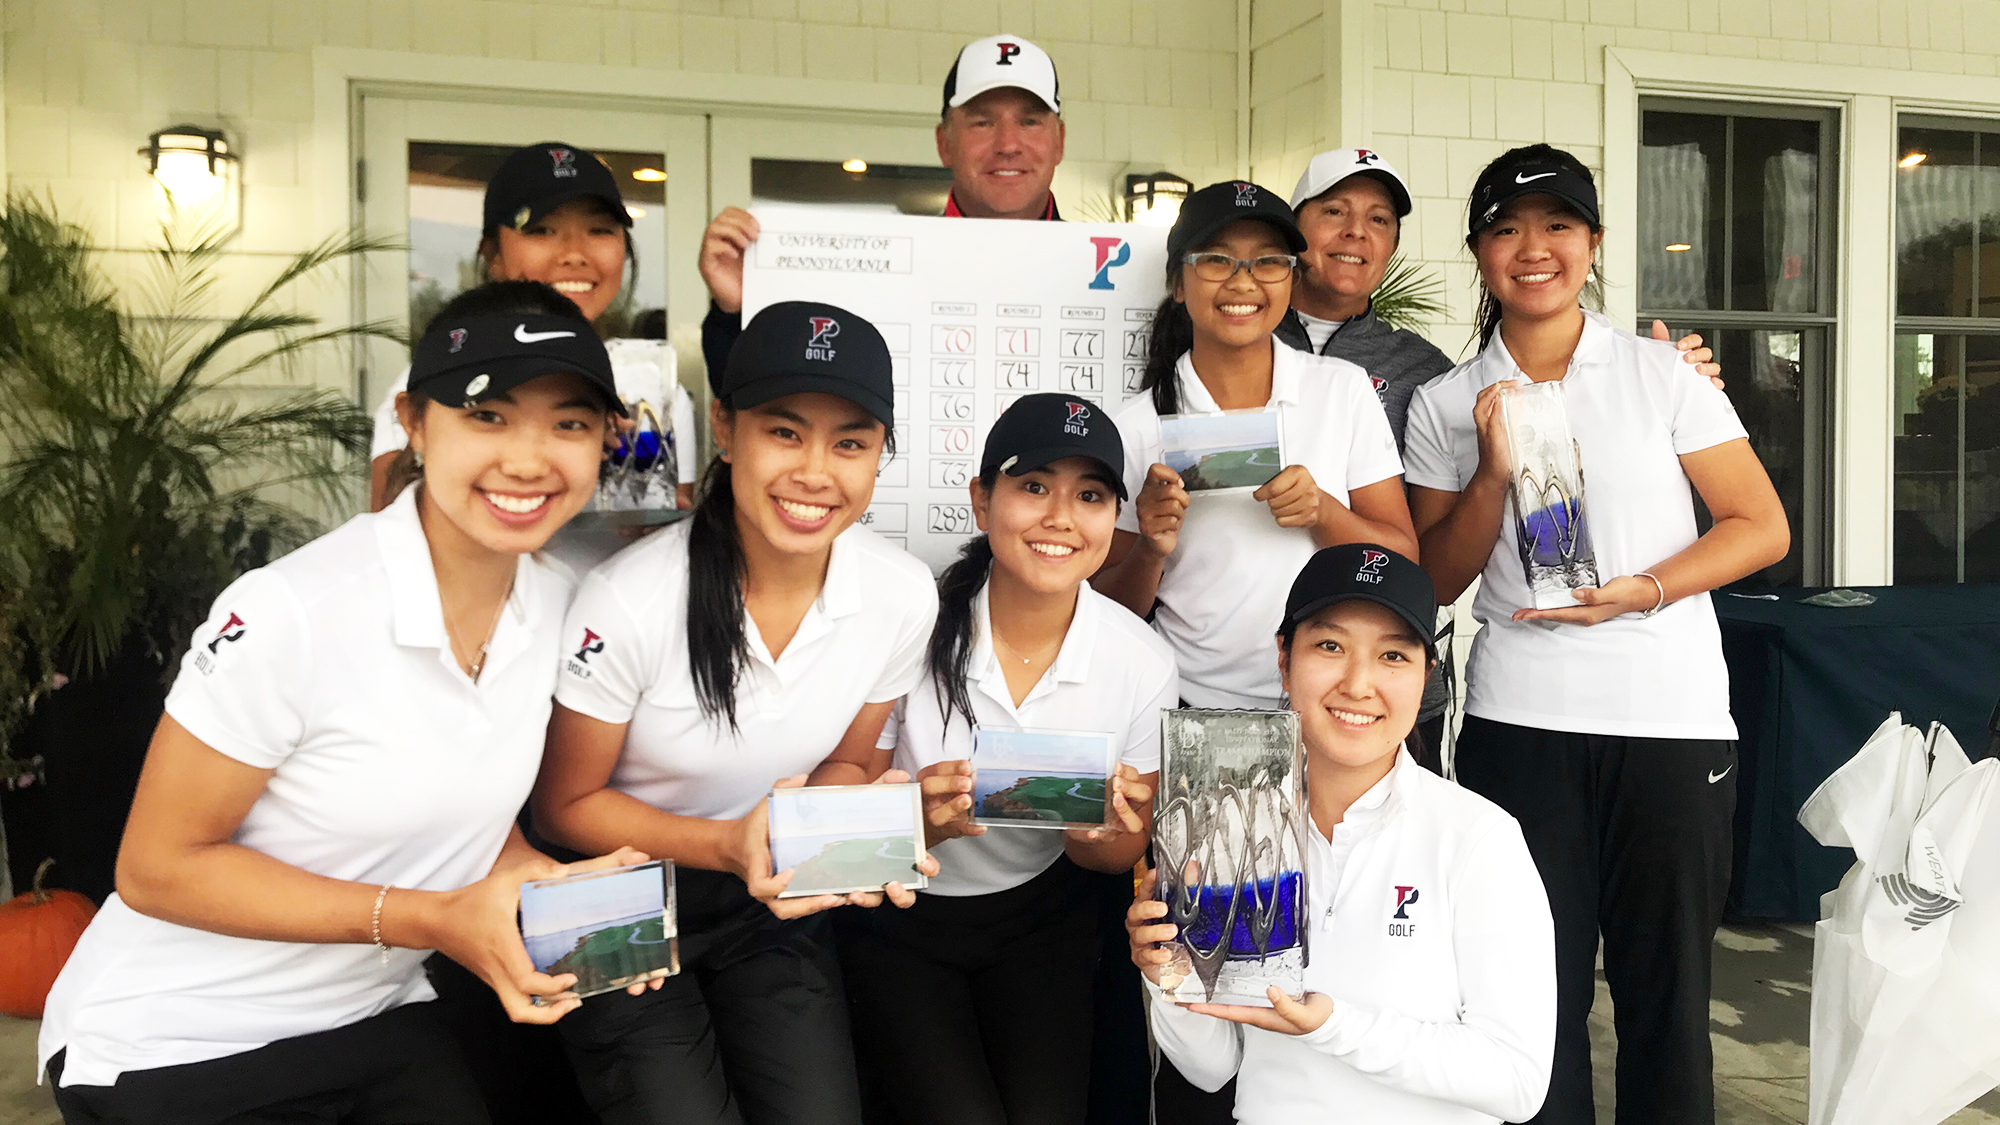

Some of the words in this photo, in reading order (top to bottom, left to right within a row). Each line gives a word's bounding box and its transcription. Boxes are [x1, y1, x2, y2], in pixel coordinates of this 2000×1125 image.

[996, 43, 1021, 65] P
[1354, 149, 1378, 166] P
[1235, 199, 1258, 208] GOLF
[778, 233, 868, 250] UNIVERSITY
[871, 237, 891, 250] OF
[775, 255, 891, 273] PENNSYLVANIA
[1088, 236, 1131, 291] P
[808, 316, 840, 349] P
[942, 326, 971, 352] 70
[1000, 329, 1028, 354] 71
[1065, 331, 1099, 356] 77
[805, 348, 836, 361] GOLF
[937, 361, 968, 386] 77
[1000, 362, 1030, 388] 74
[1063, 365, 1094, 391] 74
[938, 394, 970, 419] 76
[1065, 401, 1091, 426] P
[937, 427, 969, 453] 70
[1064, 424, 1089, 437] GOLF
[938, 461, 968, 486] 73
[930, 505, 970, 533] 289
[1360, 549, 1389, 575] P
[1355, 572, 1384, 585] GOLF
[207, 611, 246, 655] P
[574, 627, 604, 664] P
[1393, 885, 1419, 920] P
[1388, 923, 1416, 938] GOLF
